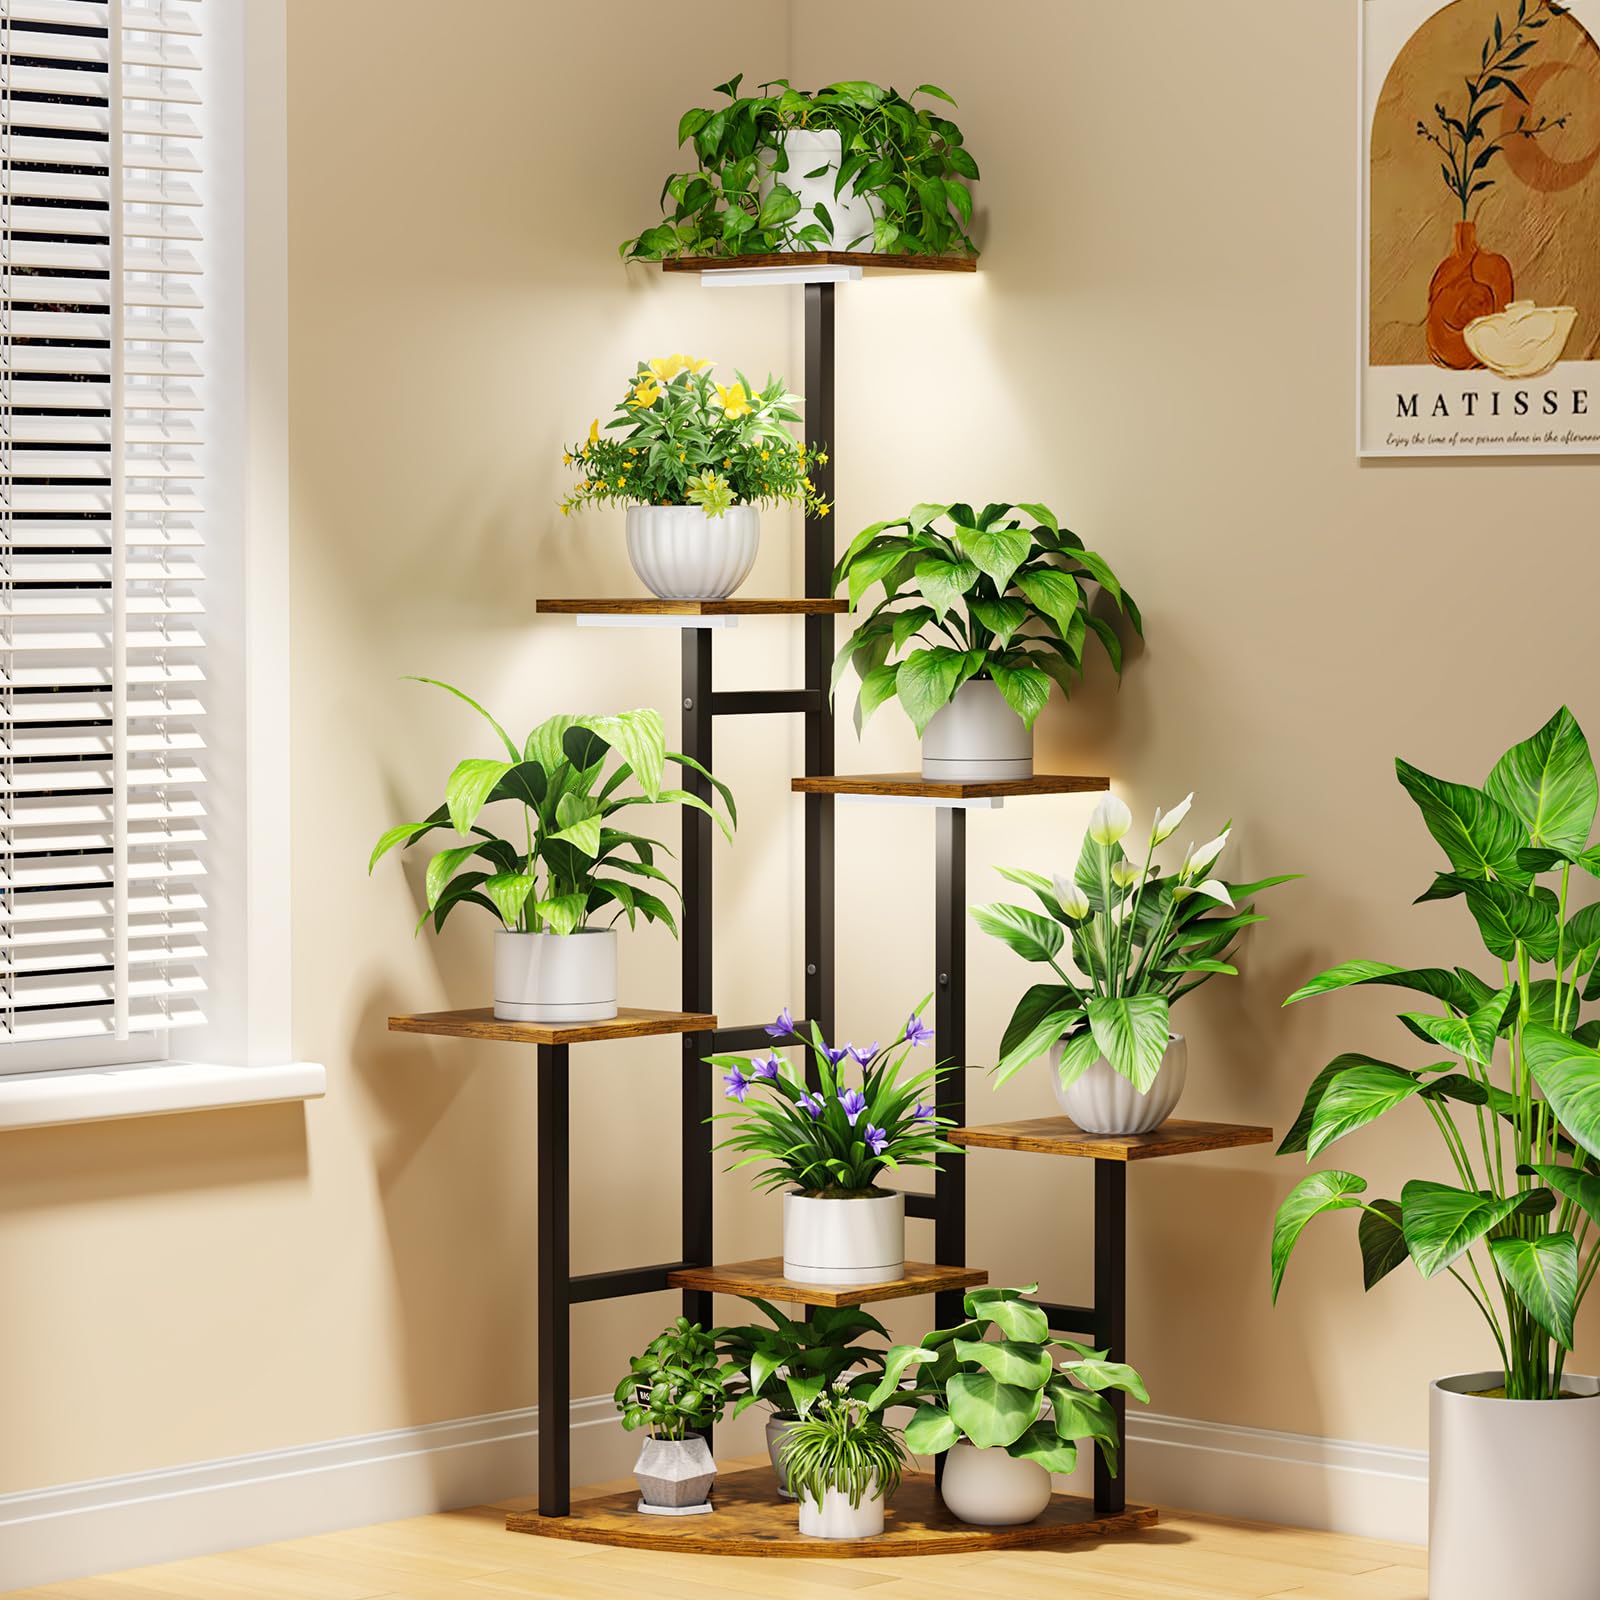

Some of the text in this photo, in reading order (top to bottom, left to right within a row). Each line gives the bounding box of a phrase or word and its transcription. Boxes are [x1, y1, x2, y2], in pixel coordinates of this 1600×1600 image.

[1396, 390, 1588, 417] MATISSE
[1386, 432, 1409, 447] Enjoy
[1412, 432, 1425, 445] the
[1428, 433, 1446, 445] time
[1449, 432, 1459, 446] of
[1460, 436, 1474, 444] one
[1475, 436, 1504, 446] person
[1507, 431, 1530, 443] alone
[1532, 433, 1541, 443] in
[1544, 430, 1558, 443] the
